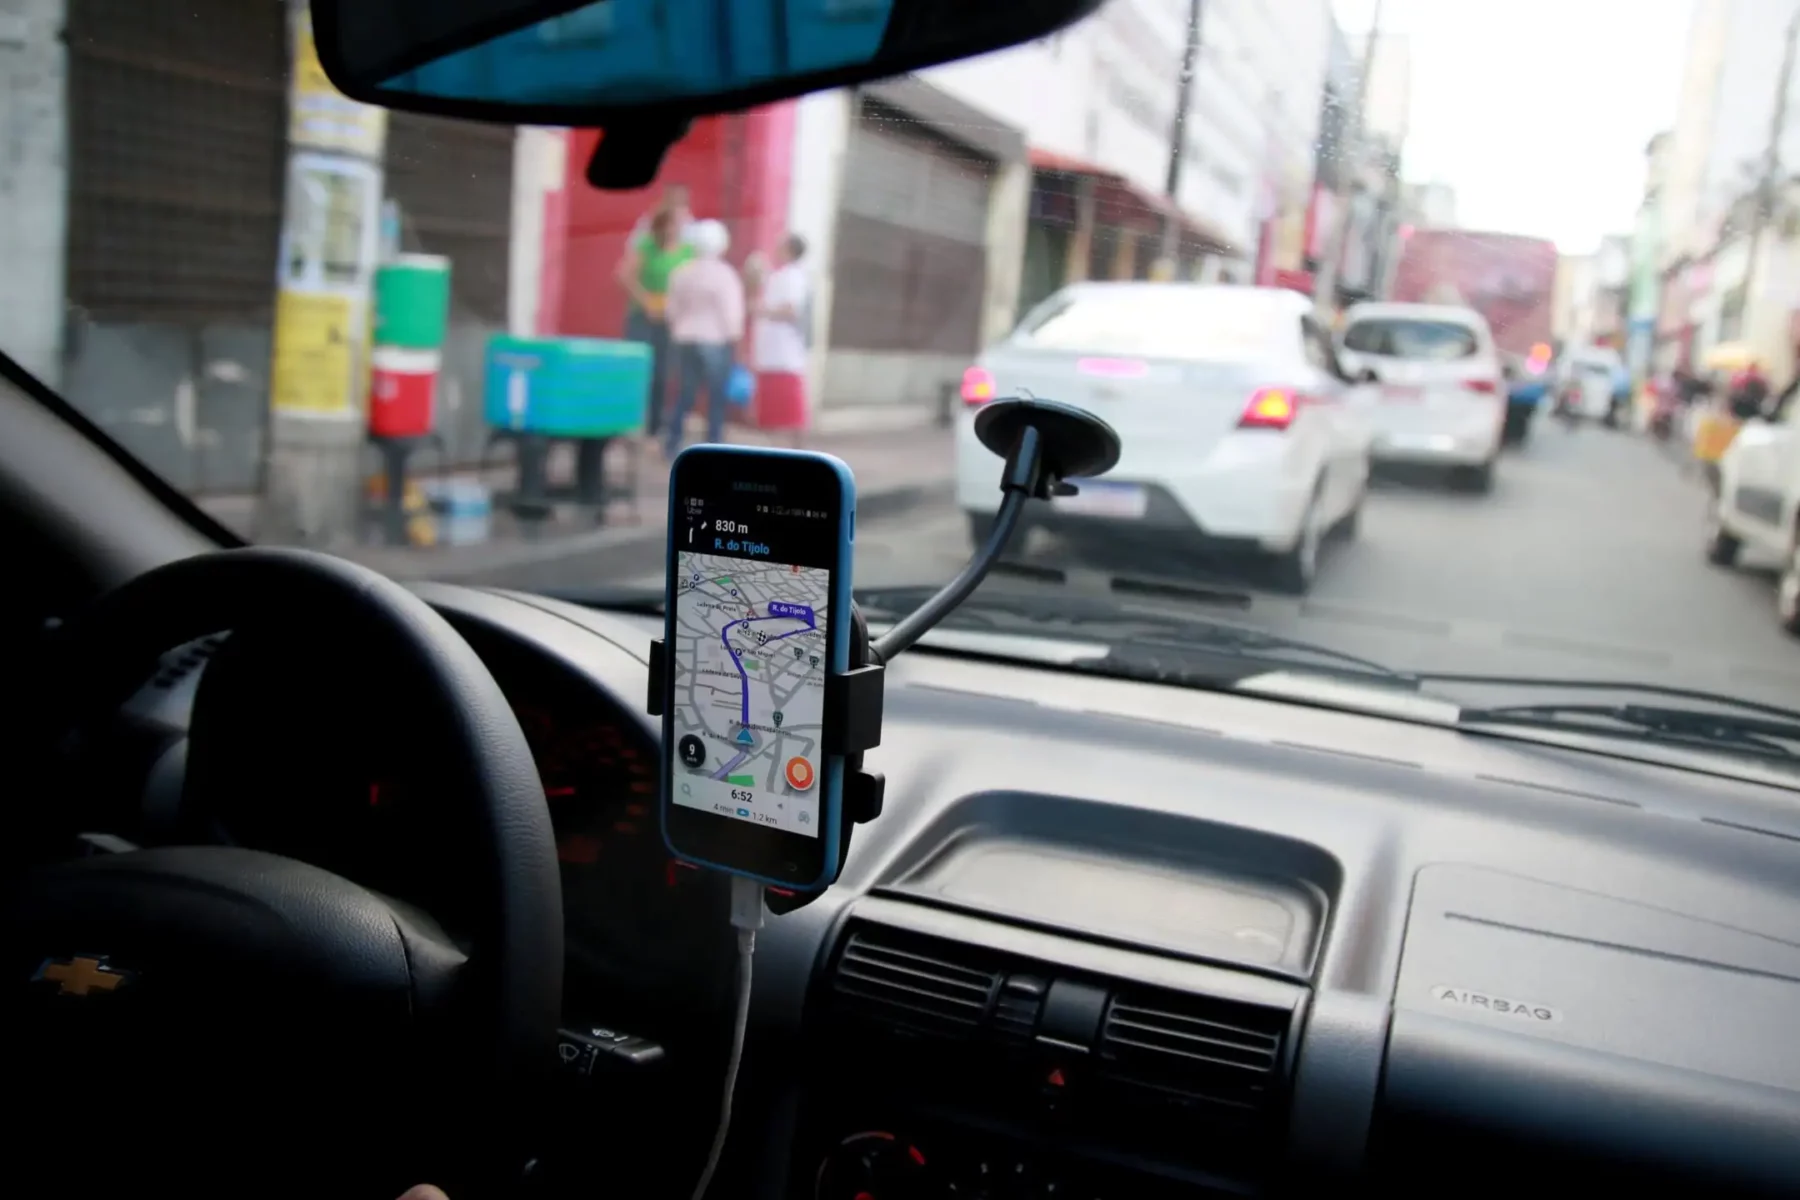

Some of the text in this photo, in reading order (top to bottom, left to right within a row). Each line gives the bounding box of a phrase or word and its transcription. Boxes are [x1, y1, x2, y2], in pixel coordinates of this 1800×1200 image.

[715, 519, 749, 534] 830 m
[714, 538, 770, 555] R. do Tijolo
[772, 604, 807, 616] R. do Tijolo
[689, 743, 696, 756] 9
[731, 789, 753, 803] 6:52
[714, 803, 778, 825] 4 min 1.2 km
[1440, 989, 1553, 1021] AIRBAG
